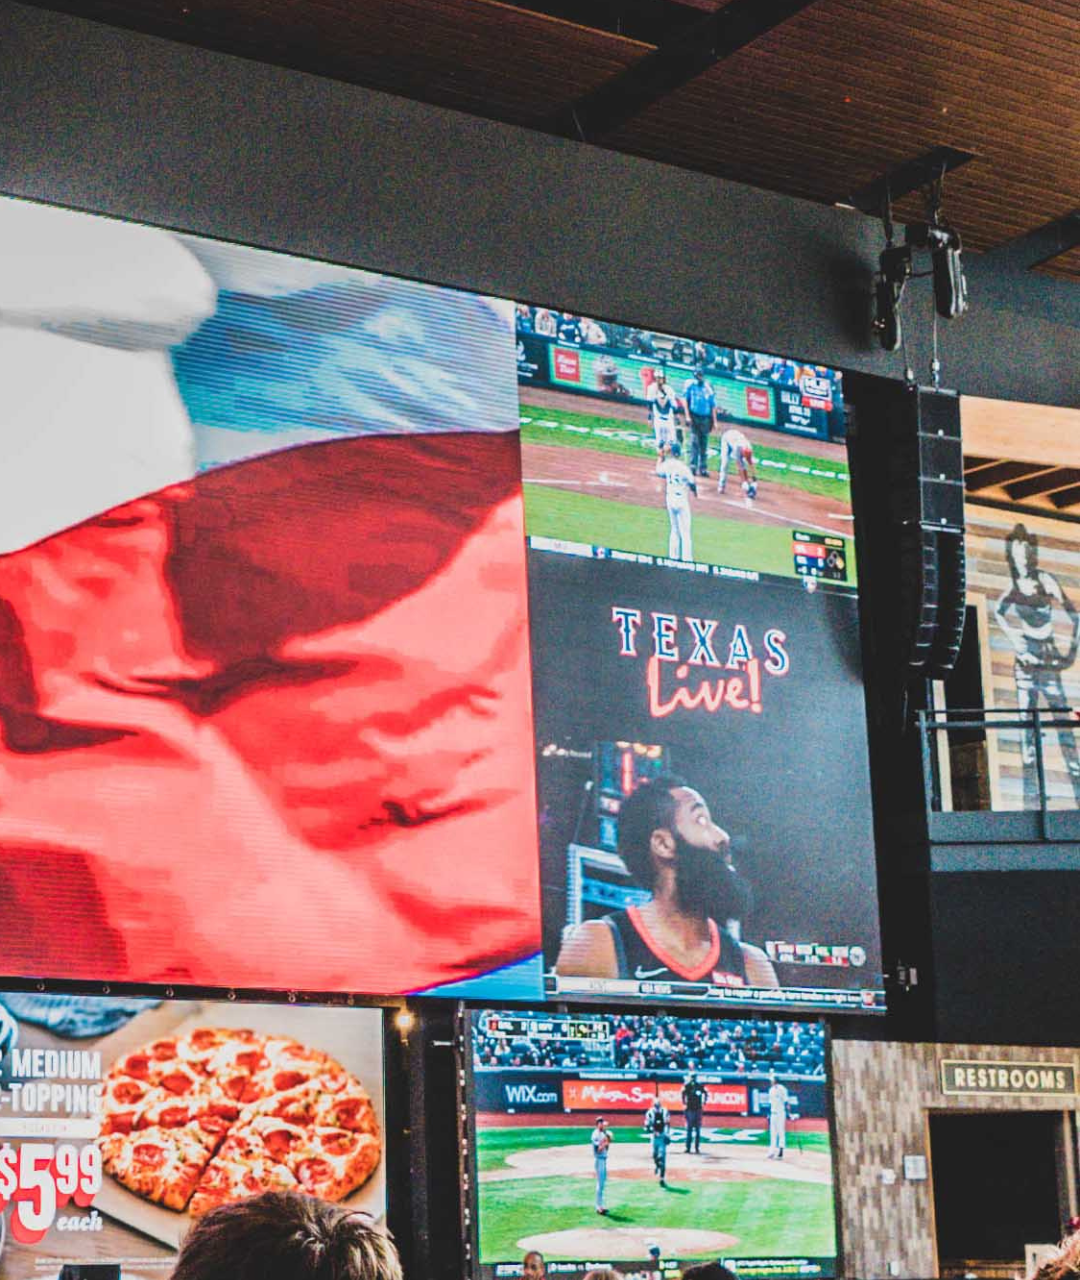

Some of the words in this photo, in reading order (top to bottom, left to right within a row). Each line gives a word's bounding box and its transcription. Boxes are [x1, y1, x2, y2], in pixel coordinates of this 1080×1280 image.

[611, 606, 789, 676] TEXAS
[647, 655, 764, 718] Live!
[11, 1048, 102, 1080] MEDIUM
[954, 1068, 1066, 1089] RESTROOMS
[505, 1084, 558, 1103] WIX.com
[56, 1210, 104, 1232] each
